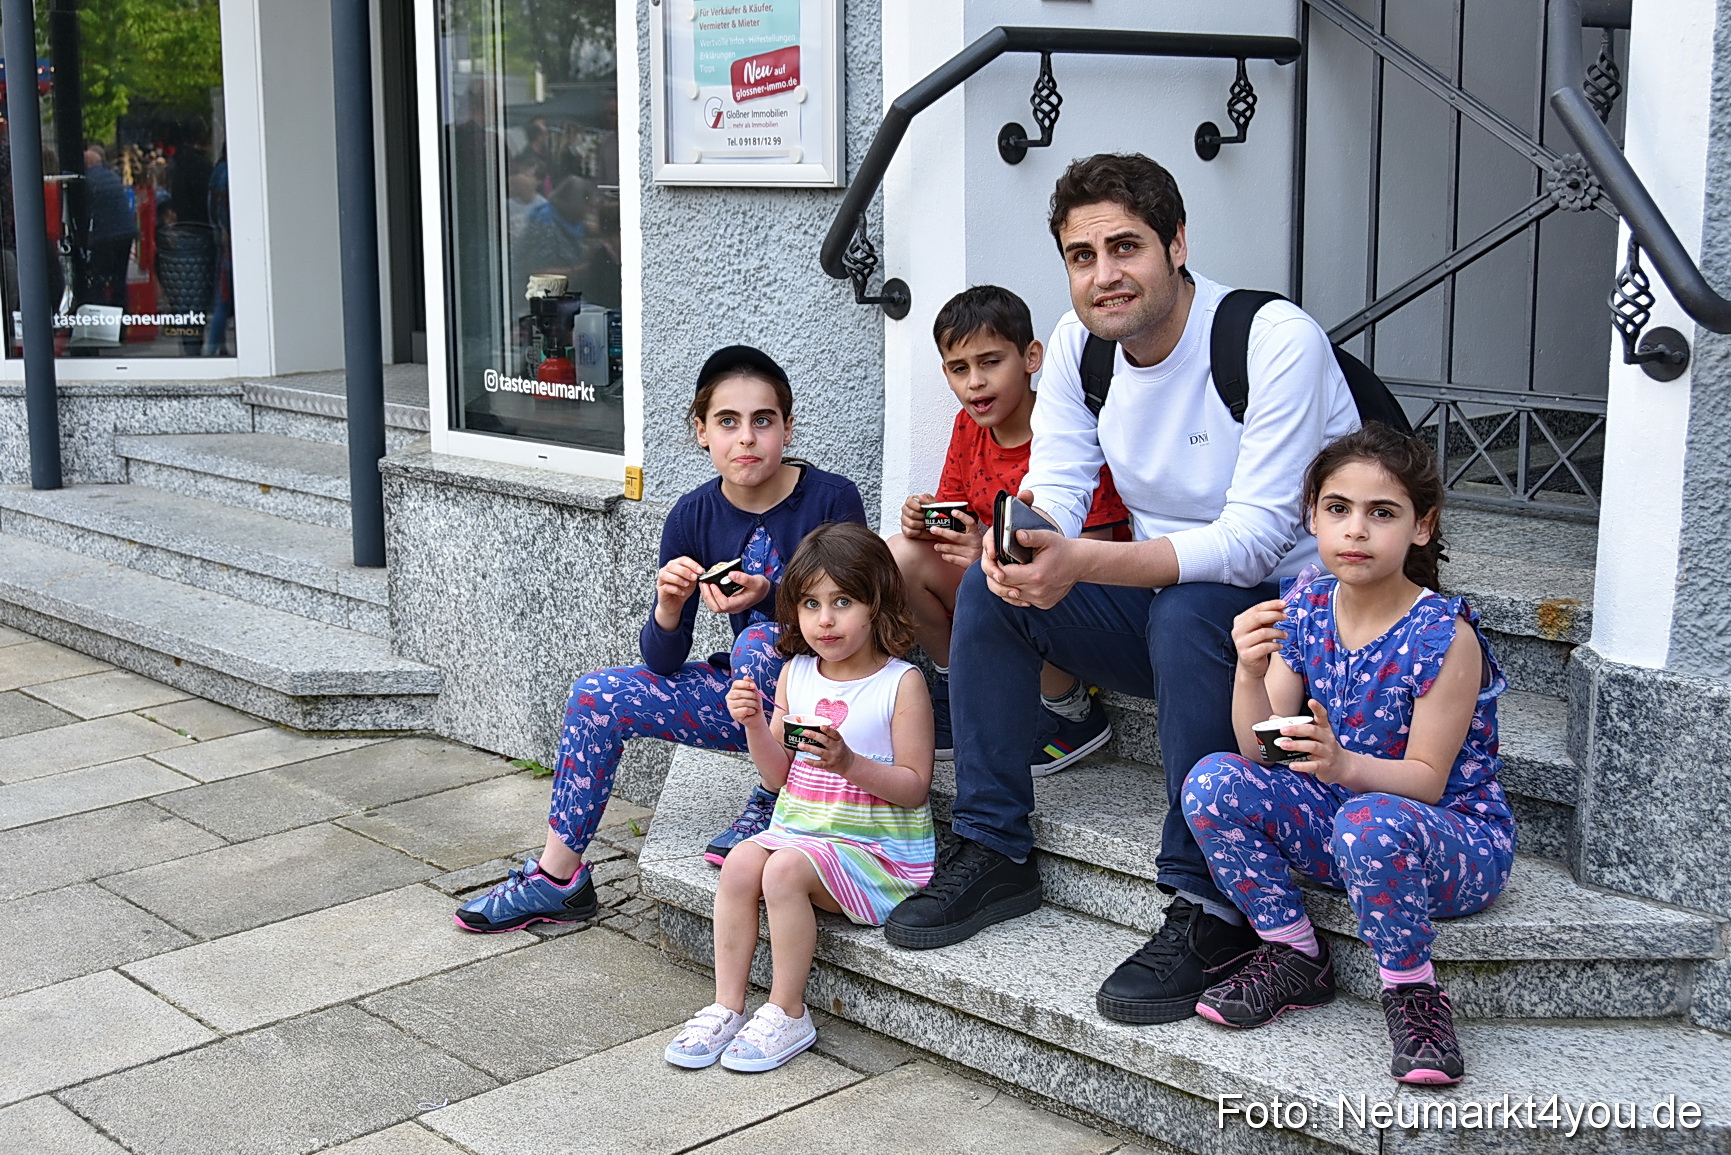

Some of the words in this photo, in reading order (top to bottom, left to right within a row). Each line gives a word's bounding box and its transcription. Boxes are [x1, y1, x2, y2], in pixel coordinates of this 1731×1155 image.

[699, 9, 709, 17] Für
[710, 6, 741, 16] Verkäufer
[743, 5, 748, 14] &
[749, 3, 774, 13] Käufer,
[699, 21, 730, 31] Vermieter
[731, 20, 737, 28] &
[738, 19, 760, 28] Mieter
[700, 37, 728, 47] Wertvolle
[729, 36, 745, 45] Infos
[748, 34, 796, 44] Hilfestellungen
[700, 51, 736, 60] Erklärungen
[700, 64, 715, 73] Tipps
[744, 60, 773, 84] Neu
[773, 64, 786, 76] auf
[736, 78, 798, 101] glossner-immo.de
[726, 110, 750, 119] Gloßner
[751, 108, 788, 118] Immobilien
[727, 137, 738, 146] Tel.
[773, 136, 782, 145] 99
[53, 309, 206, 327] tastestoreneumarkt
[499, 373, 595, 402] tasteneumarkt
